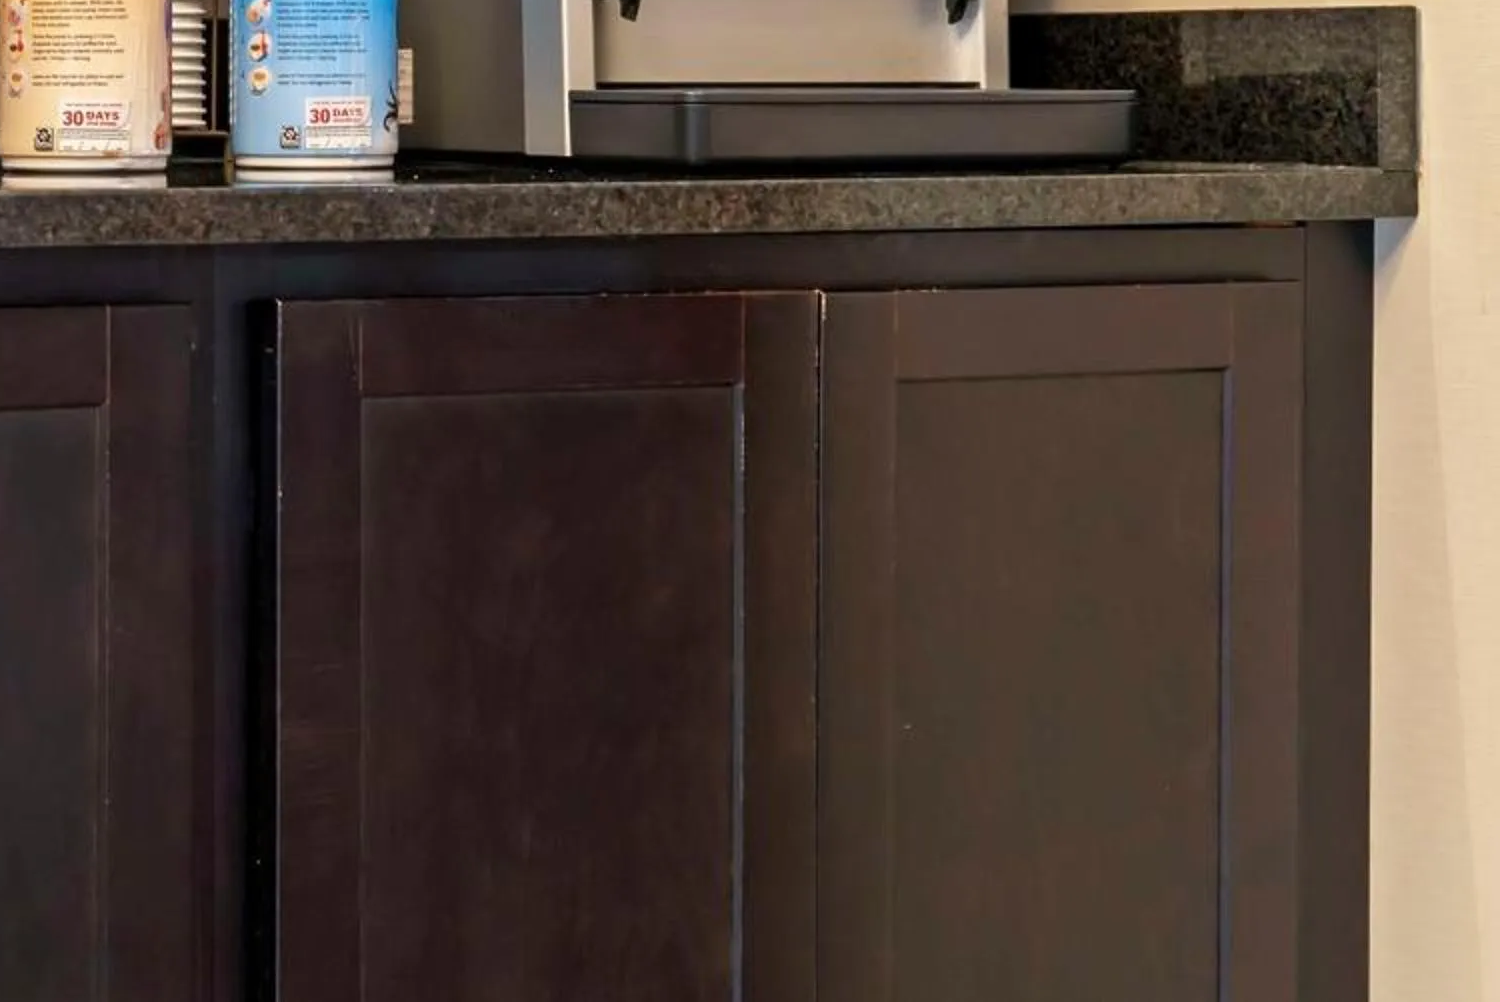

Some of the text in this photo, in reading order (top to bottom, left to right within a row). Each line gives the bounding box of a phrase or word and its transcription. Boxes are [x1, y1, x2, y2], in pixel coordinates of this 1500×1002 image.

[63, 110, 120, 126] 30 DAYS
[310, 108, 331, 124] 30
